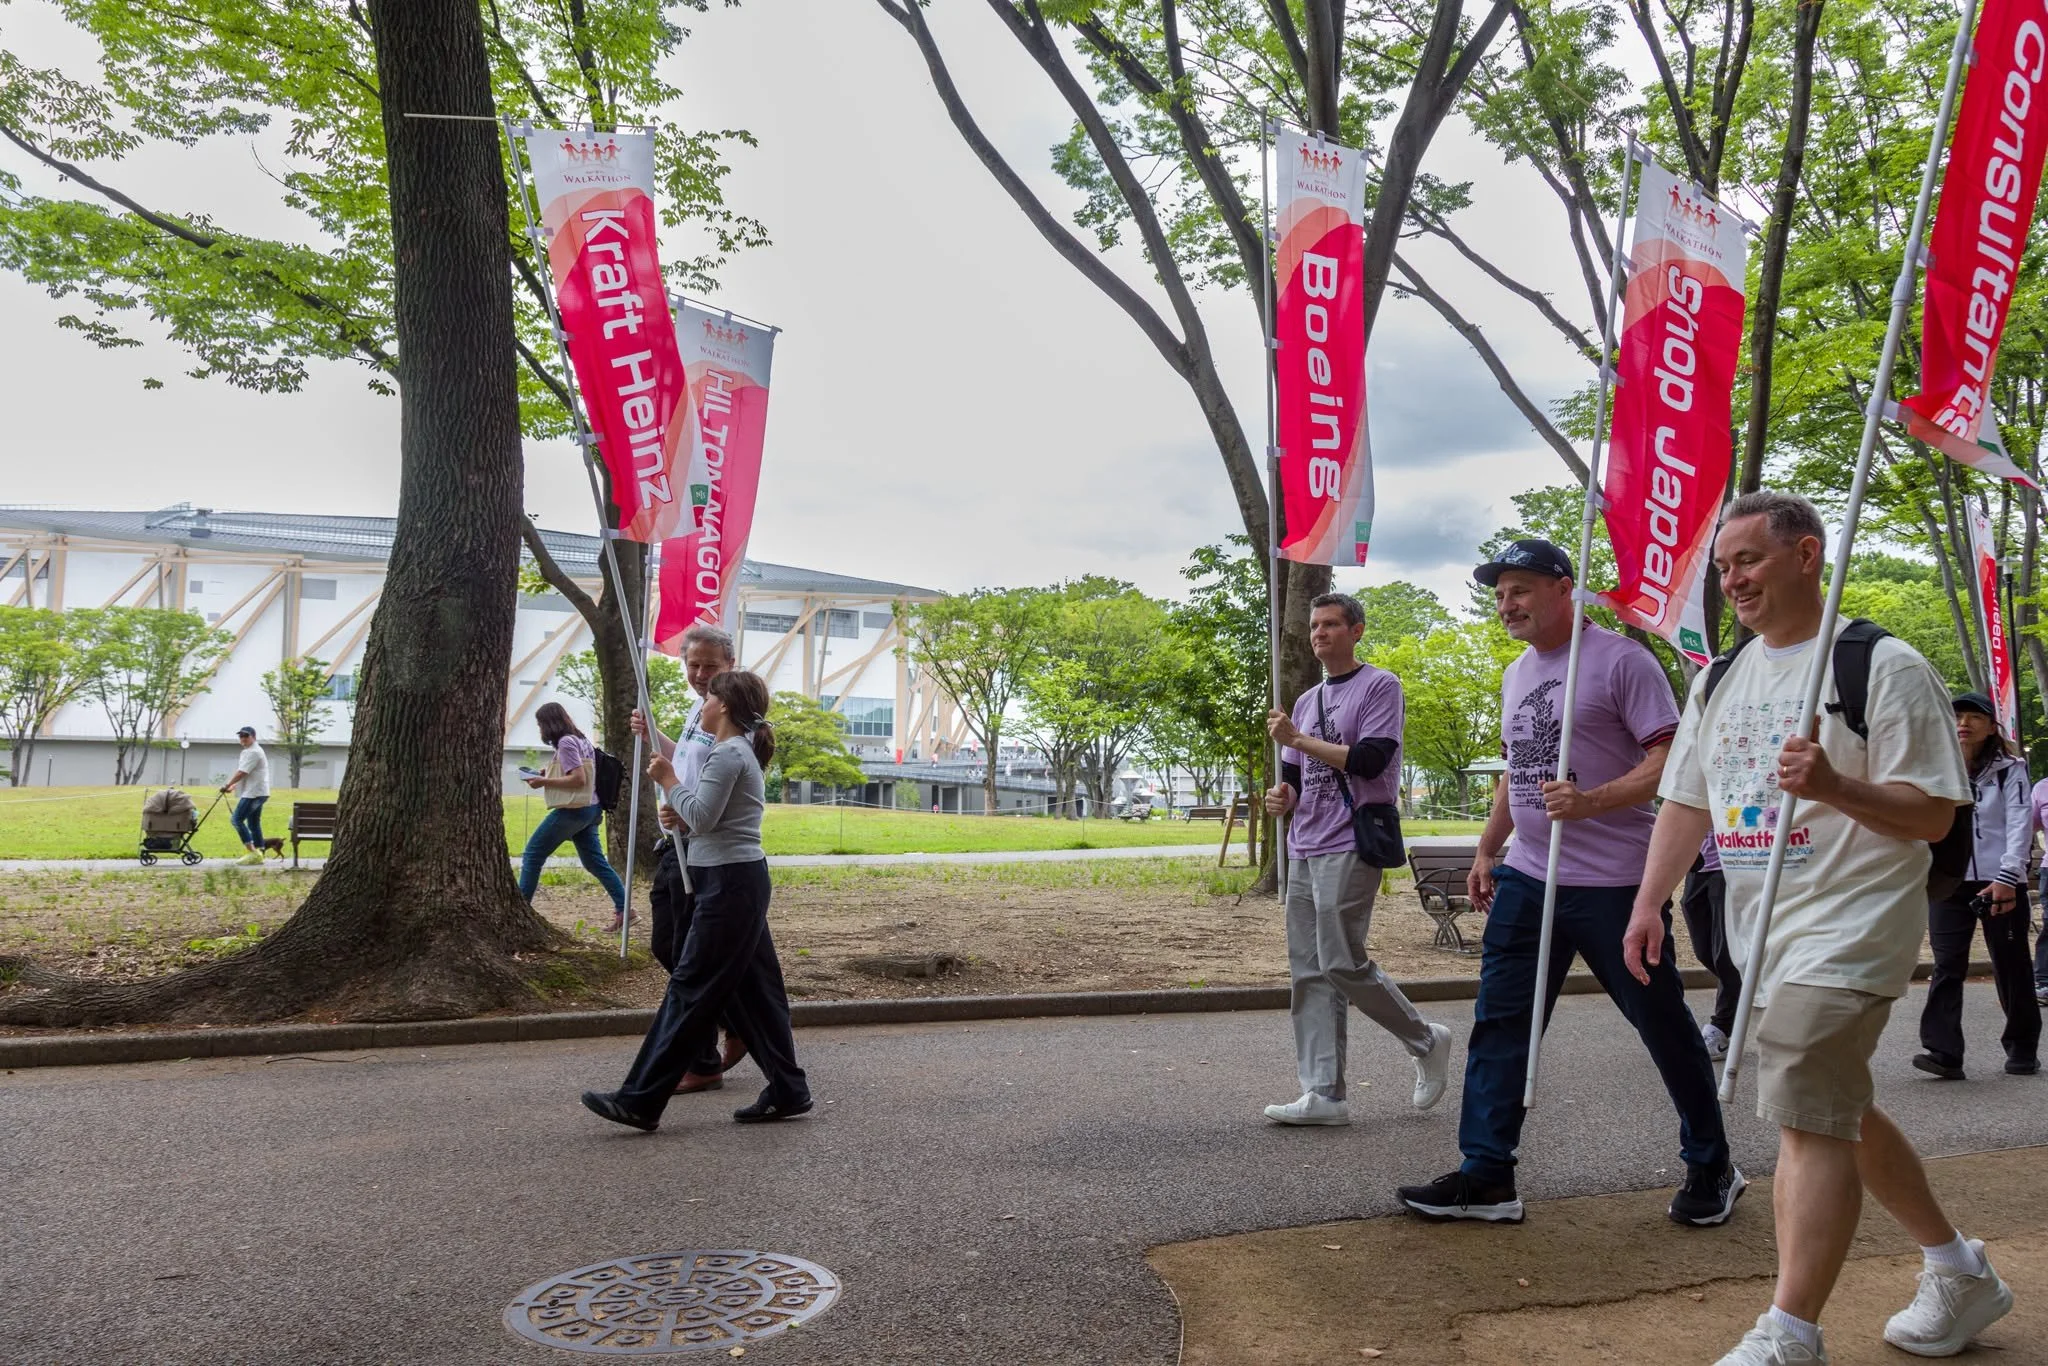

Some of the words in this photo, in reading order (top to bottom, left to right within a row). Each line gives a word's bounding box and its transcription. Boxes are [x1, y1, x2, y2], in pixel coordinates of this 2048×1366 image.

[563, 174, 631, 184] WALKATHON
[1296, 179, 1347, 199] WALKATHON
[581, 208, 645, 340] Kraft
[1654, 264, 1704, 413] Shop
[611, 349, 673, 509] Heinz
[702, 368, 734, 492] HILTON
[1302, 250, 1344, 502] Boeing
[1633, 425, 1696, 629] Japan
